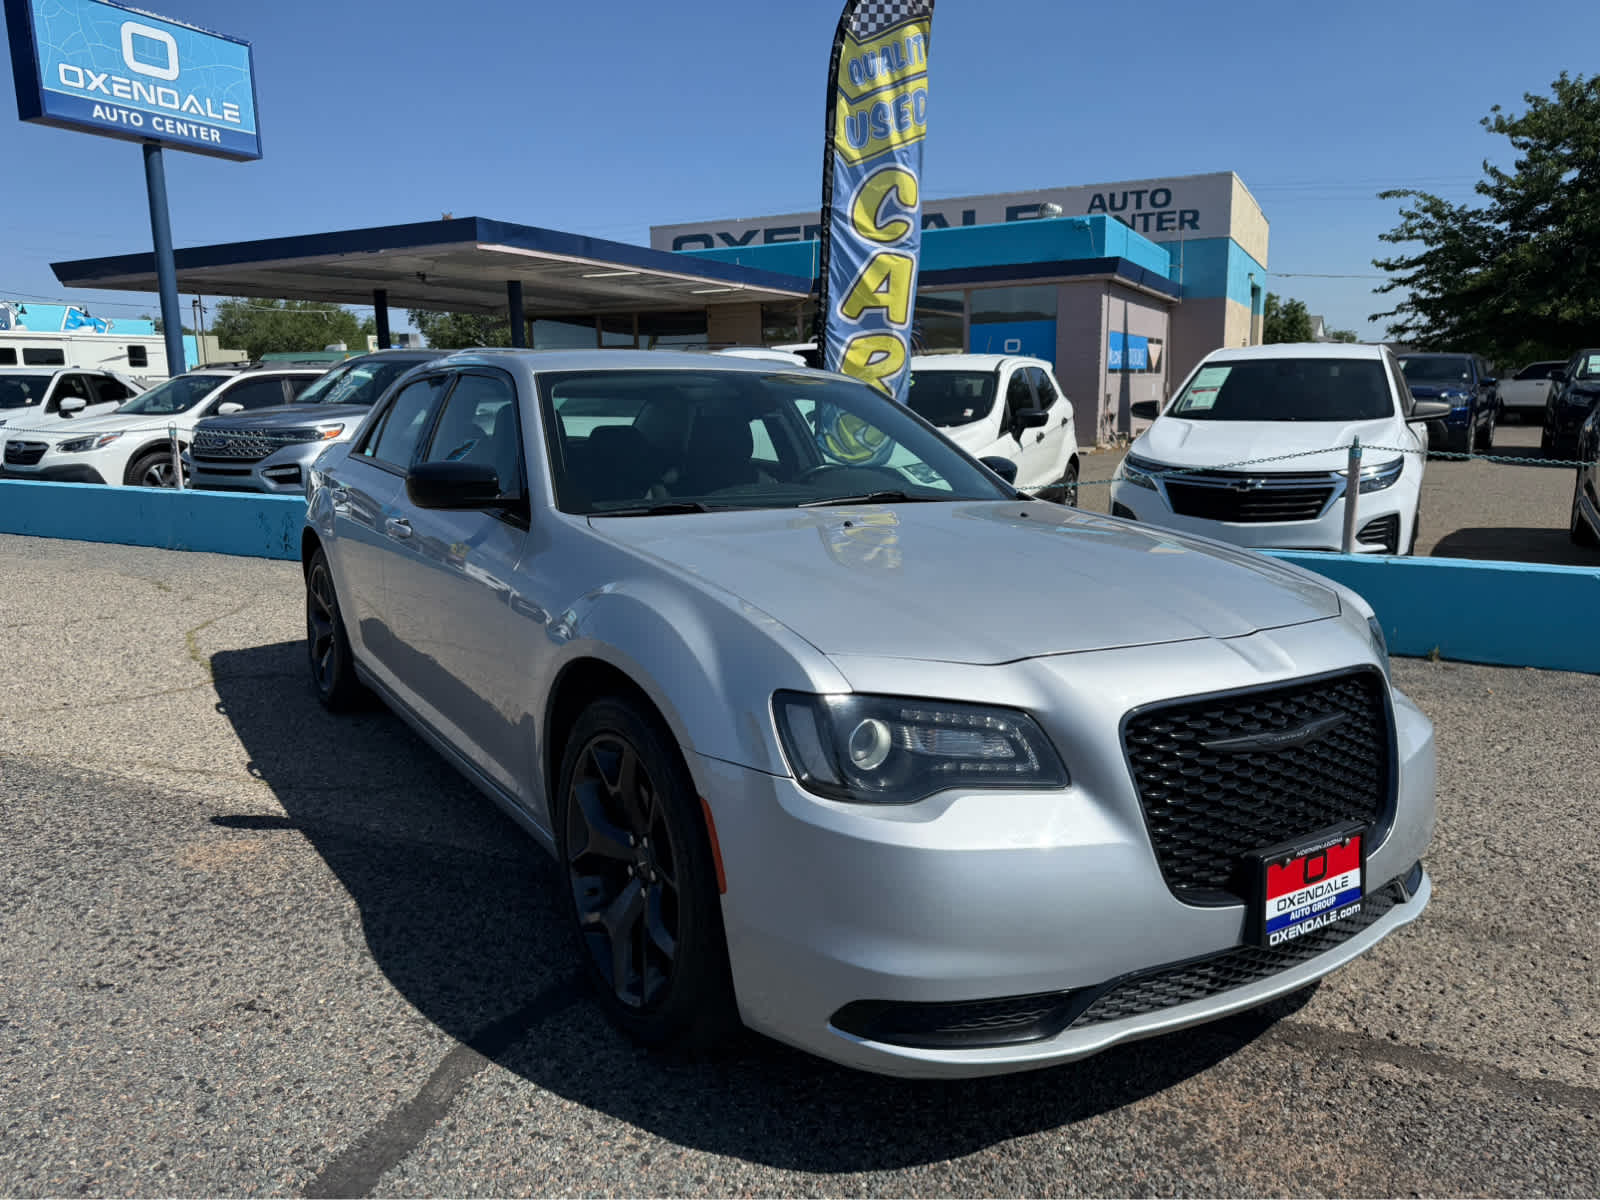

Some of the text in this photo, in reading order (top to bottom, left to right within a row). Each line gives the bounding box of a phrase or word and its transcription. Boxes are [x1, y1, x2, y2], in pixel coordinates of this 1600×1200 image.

[58, 62, 241, 124] OXENDALE
[92, 104, 222, 144] AUTO CENTER
[845, 88, 928, 149] USED
[1088, 188, 1172, 214] AUTO
[1112, 209, 1201, 233] NTER
[1276, 876, 1349, 912] OXENDALE
[1289, 896, 1337, 921] AUTO GROUP
[1269, 904, 1361, 946] OXENDALE.com
